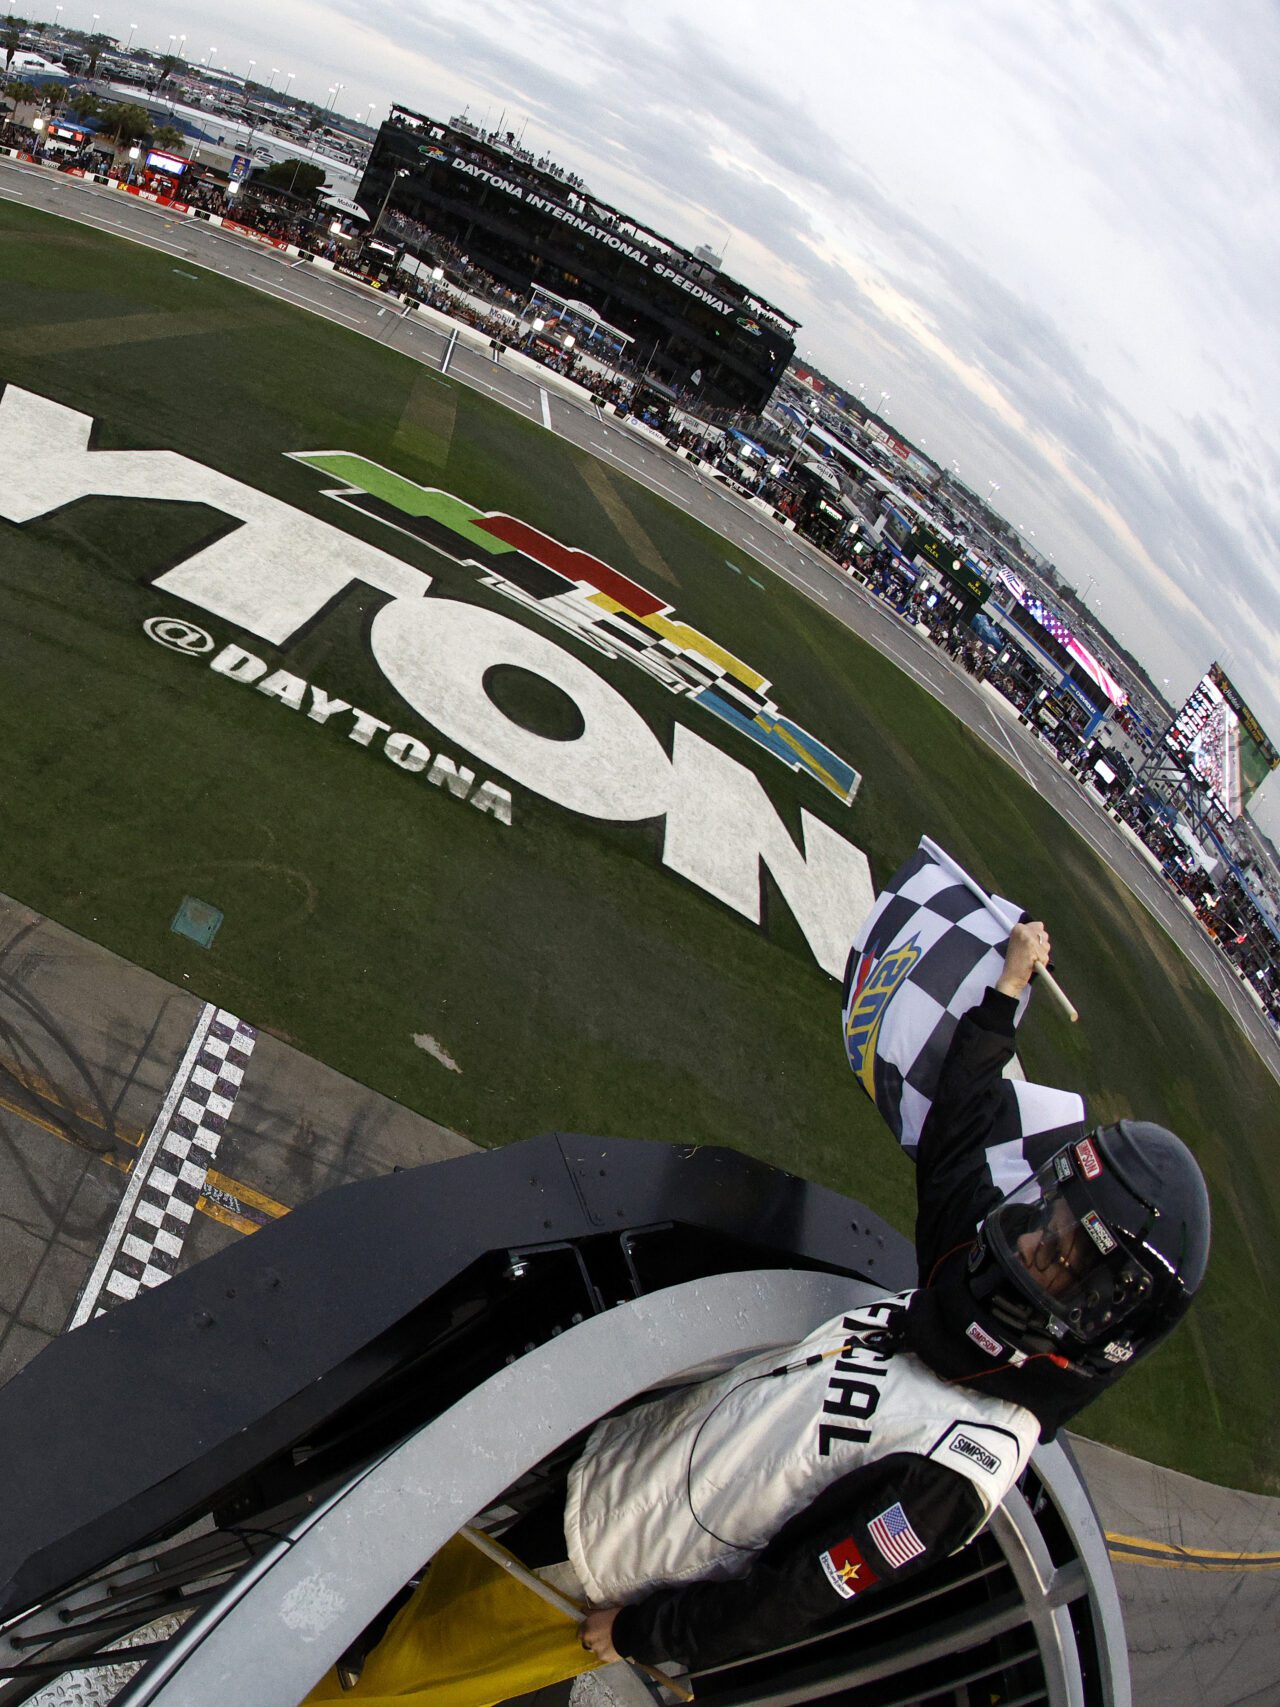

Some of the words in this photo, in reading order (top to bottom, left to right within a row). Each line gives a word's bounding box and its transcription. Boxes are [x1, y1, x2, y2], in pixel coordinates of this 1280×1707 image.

[337, 198, 353, 209] Mobil
[451, 157, 523, 199] DAYTONA
[525, 192, 648, 267] INTERNATIONAL
[652, 260, 734, 316] SPEEDWAY
[489, 307, 512, 324] Mobil
[1075, 690, 1096, 714] CHEVROLET
[210, 643, 512, 826] DAYTONA
[1078, 1140, 1100, 1176] SIMPSON
[1083, 1219, 1106, 1254] OFFICIAL
[1093, 1221, 1114, 1249] NASCAR
[970, 1327, 998, 1354] SIMPSON
[1104, 1341, 1134, 1362] BUSCH
[818, 1291, 912, 1457] FICIAL
[954, 1438, 997, 1470] SIMPSON
